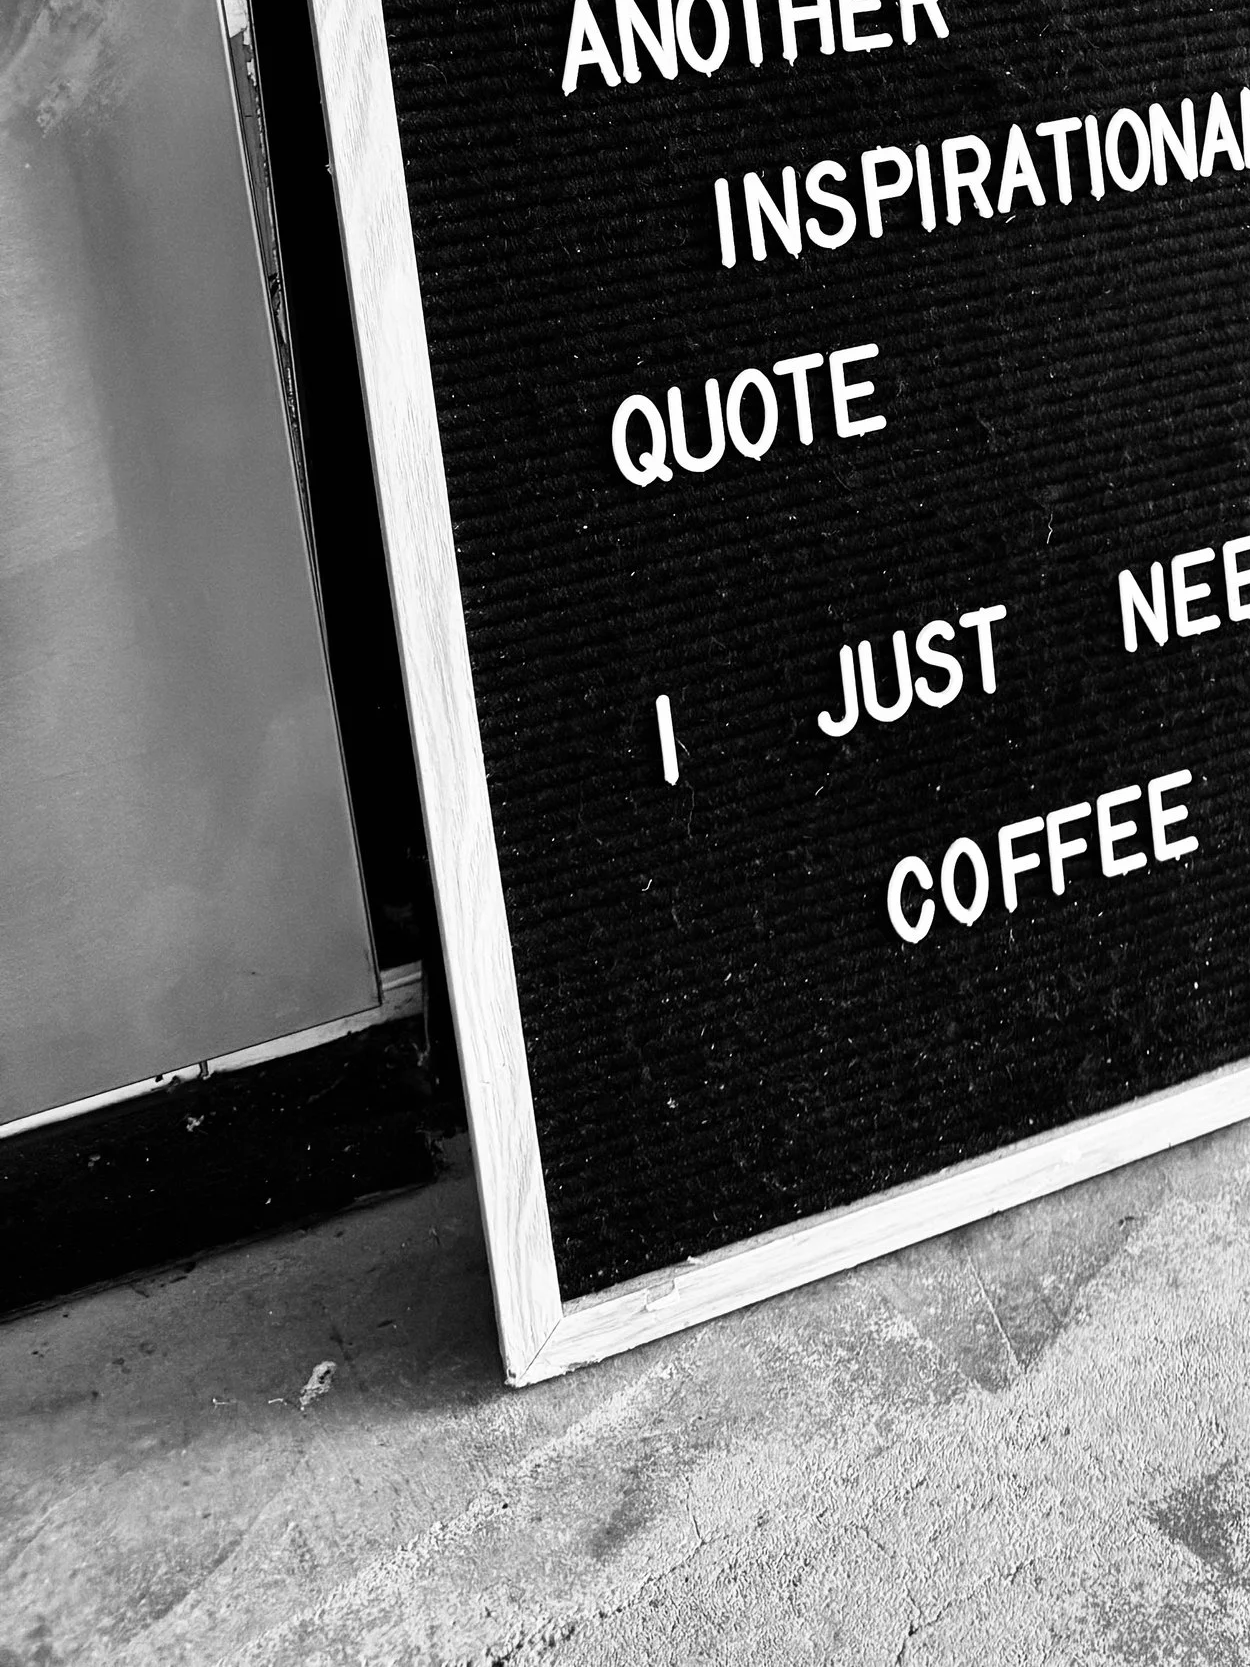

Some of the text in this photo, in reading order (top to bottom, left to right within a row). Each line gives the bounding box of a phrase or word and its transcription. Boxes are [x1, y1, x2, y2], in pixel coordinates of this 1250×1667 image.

[611, 343, 887, 487] QUOTE
[656, 695, 680, 785] I
[818, 605, 1006, 736] JUST
[887, 770, 1199, 943] COFFEE
